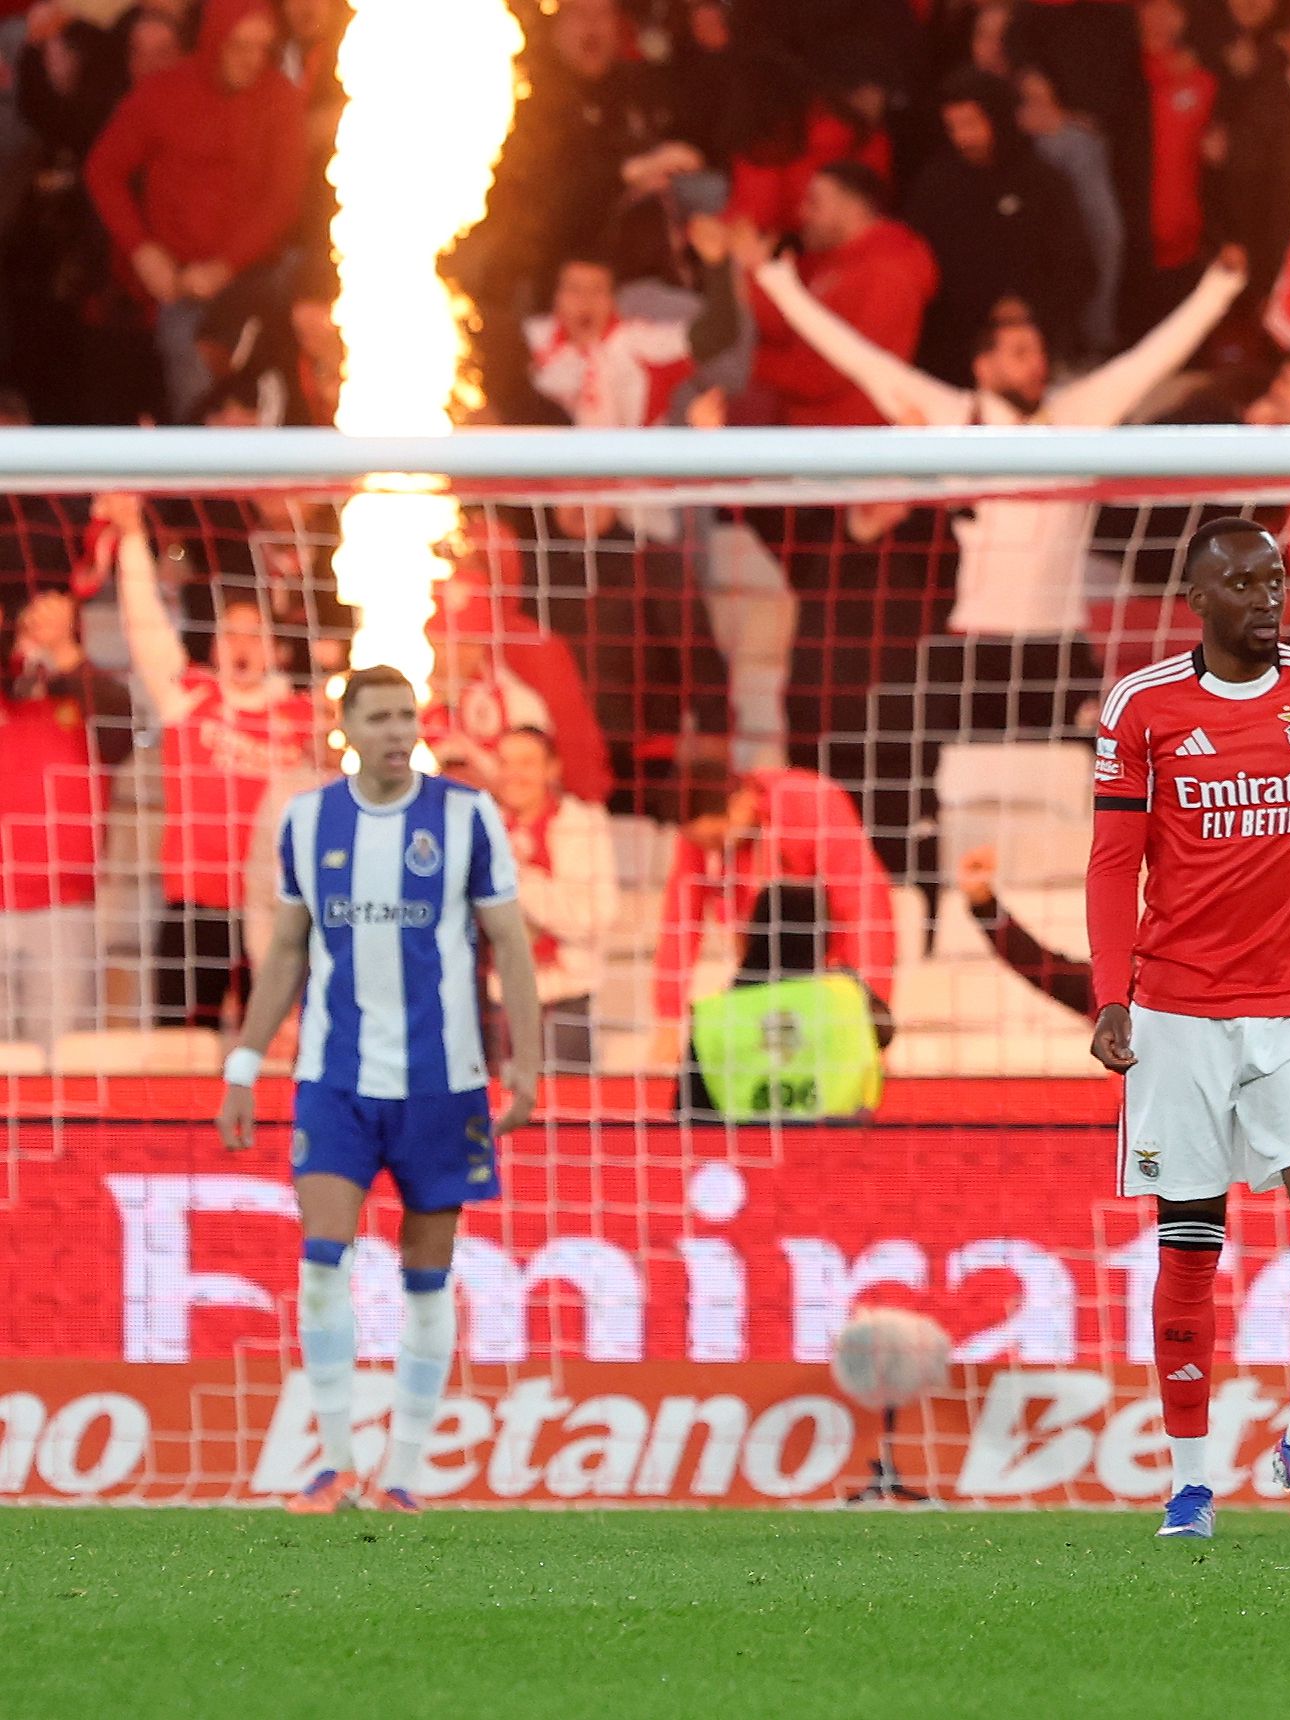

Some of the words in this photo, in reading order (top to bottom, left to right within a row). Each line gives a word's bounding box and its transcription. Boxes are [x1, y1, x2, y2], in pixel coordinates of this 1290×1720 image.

[1202, 811, 1235, 839] FLY
[324, 896, 434, 928] Betano
[250, 1370, 855, 1498] Betano
